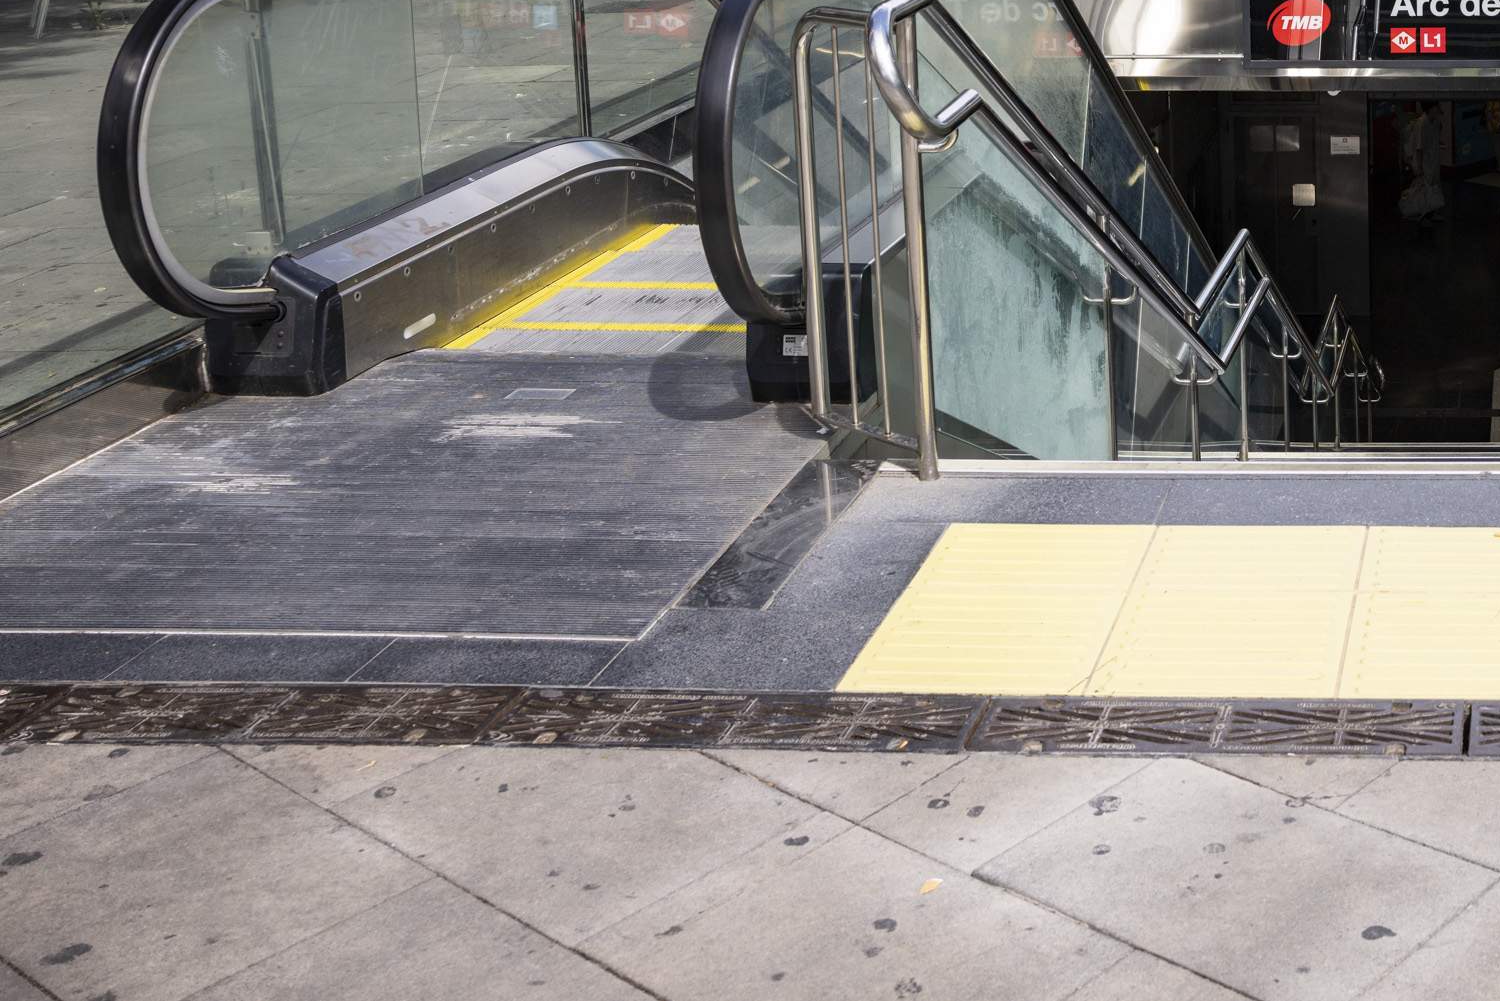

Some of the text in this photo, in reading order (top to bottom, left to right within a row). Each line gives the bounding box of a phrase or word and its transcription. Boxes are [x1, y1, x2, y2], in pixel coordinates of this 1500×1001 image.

[1281, 15, 1323, 30] TMB
[1398, 35, 1410, 46] M
[1422, 33, 1443, 48] L1
